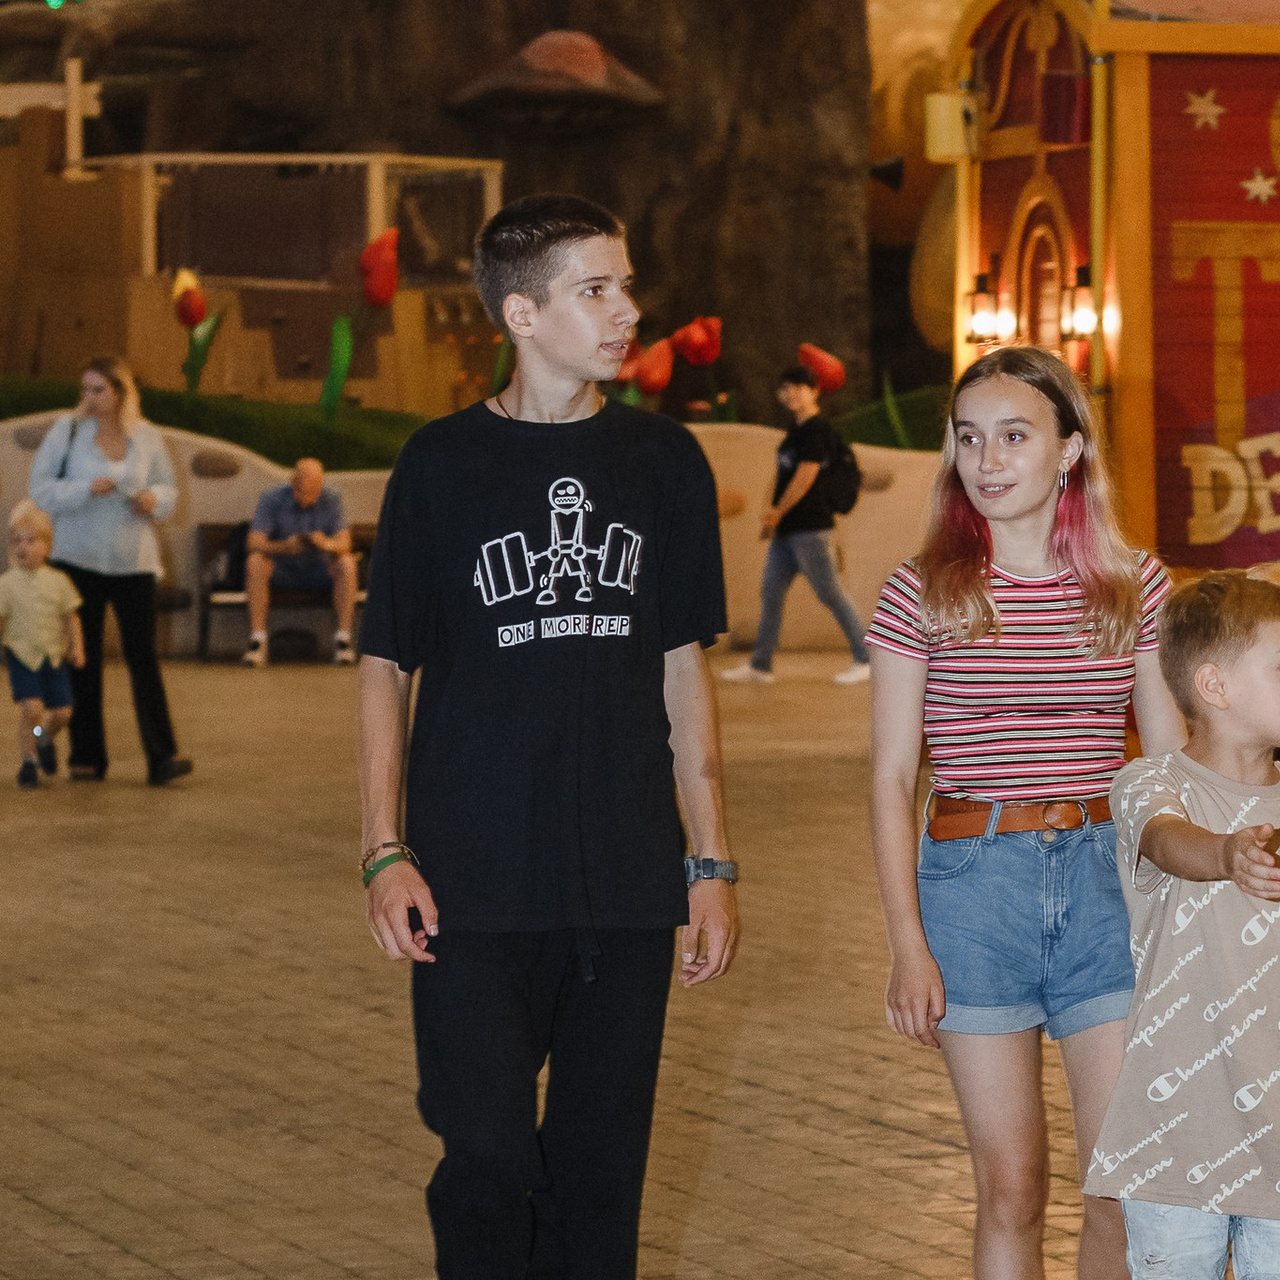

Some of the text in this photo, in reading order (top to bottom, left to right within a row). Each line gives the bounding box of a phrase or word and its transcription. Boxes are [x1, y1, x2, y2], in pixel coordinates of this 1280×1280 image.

[498, 615, 630, 647] ONE MORE REP
[1203, 955, 1278, 1022] Champion
[1147, 1005, 1267, 1102] Champion
[1102, 1111, 1189, 1176] Champion
[1186, 1123, 1273, 1184] Champion
